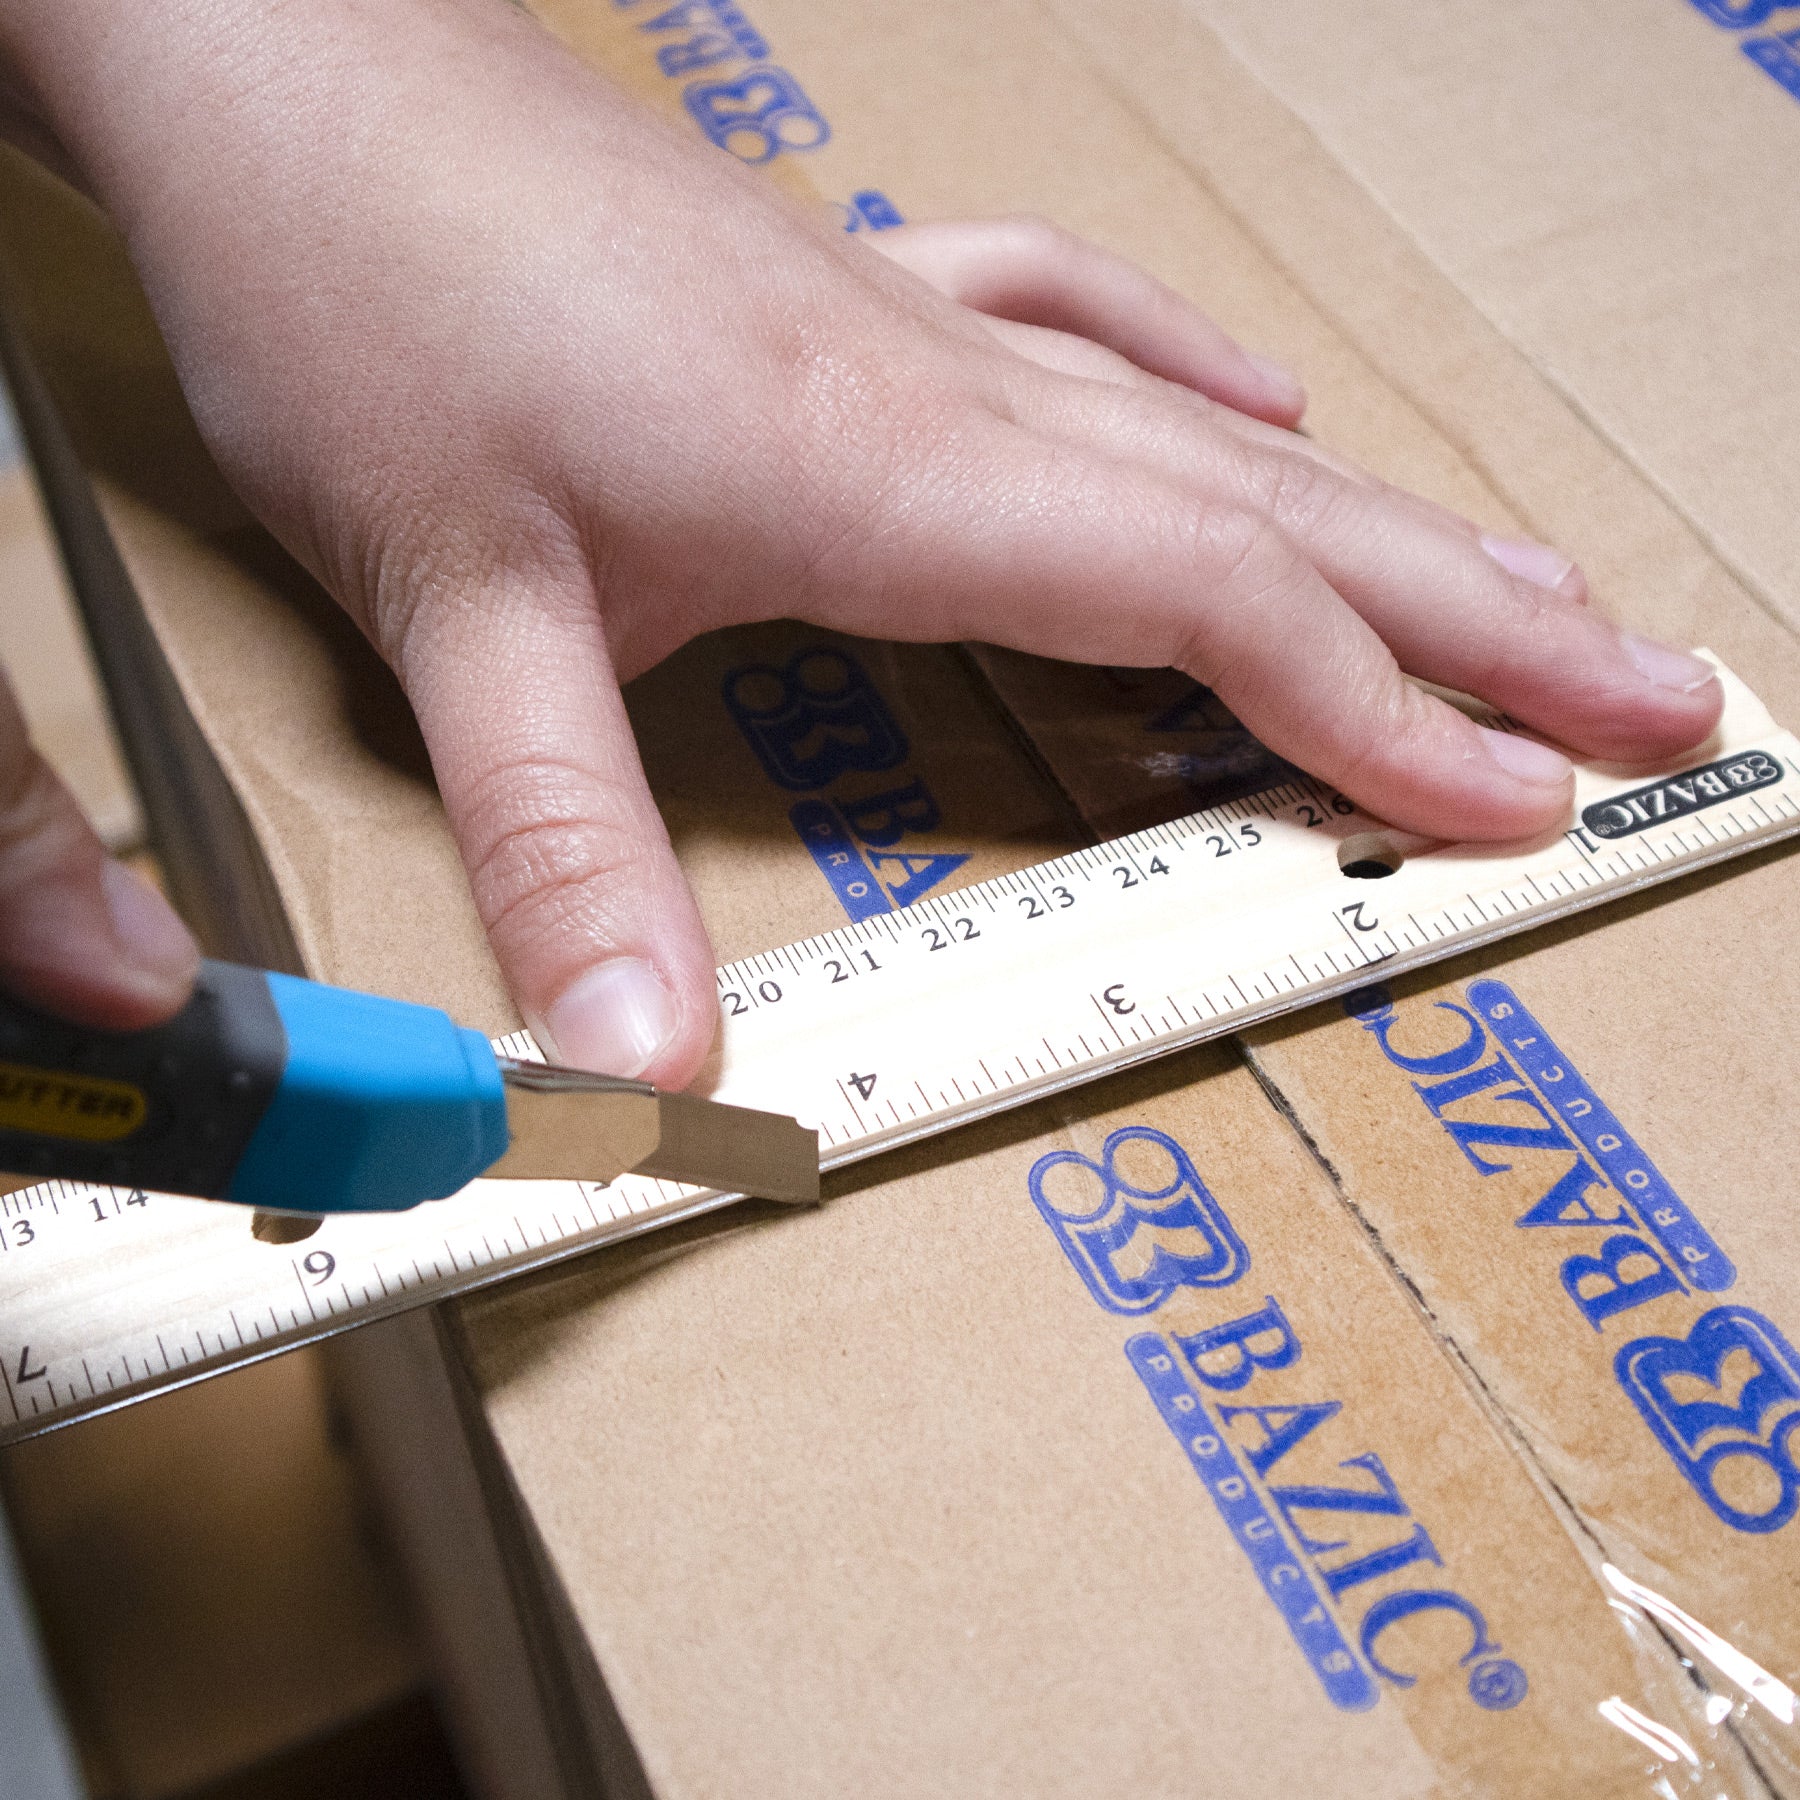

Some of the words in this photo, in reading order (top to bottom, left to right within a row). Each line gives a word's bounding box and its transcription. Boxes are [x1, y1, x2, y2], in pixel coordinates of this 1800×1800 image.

[1601, 771, 1732, 830] BAZIC
[1205, 823, 1262, 857] 25
[1112, 855, 1170, 888] 24
[1018, 886, 1076, 919] 23
[1341, 901, 1379, 932] 2
[921, 917, 981, 951] 22
[823, 950, 882, 983] 21
[722, 980, 783, 1016] 20
[1103, 984, 1136, 1015] 3
[848, 1072, 877, 1101] 4
[1491, 1002, 1710, 1264] PRODUCTS
[1363, 1001, 1690, 1334] BAZIC
[88, 1188, 149, 1222] 14
[16, 1346, 48, 1384] 7
[1170, 1295, 1502, 1688] BAZIC
